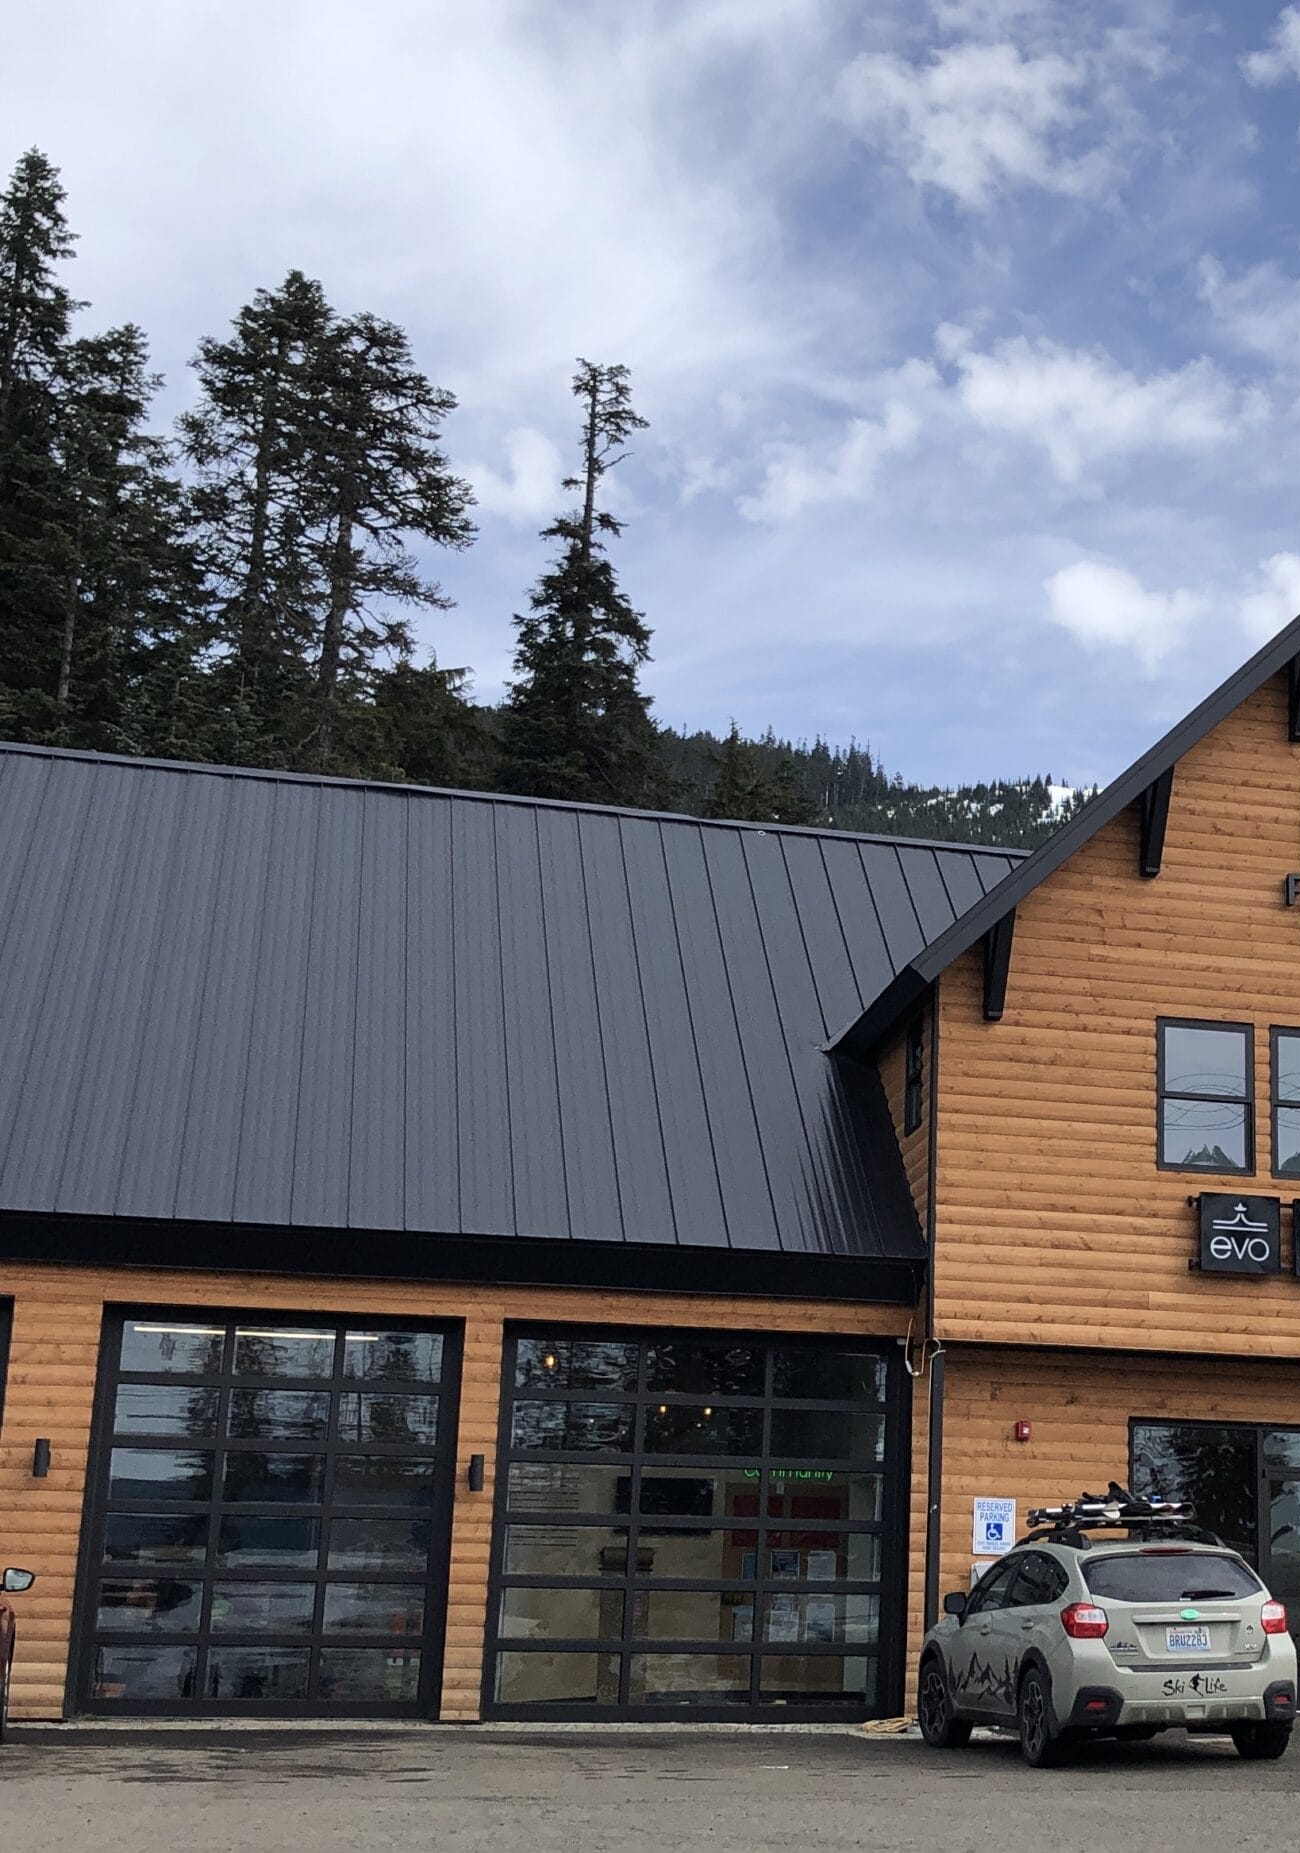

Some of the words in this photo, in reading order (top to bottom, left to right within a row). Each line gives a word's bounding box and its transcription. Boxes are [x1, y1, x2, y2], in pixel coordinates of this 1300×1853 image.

[1210, 1236, 1270, 1262] evo
[977, 1501, 1013, 1513] RESERVED
[980, 1512, 1010, 1522] PARKING
[1161, 1678, 1186, 1697] Ski
[1205, 1677, 1228, 1695] Life
